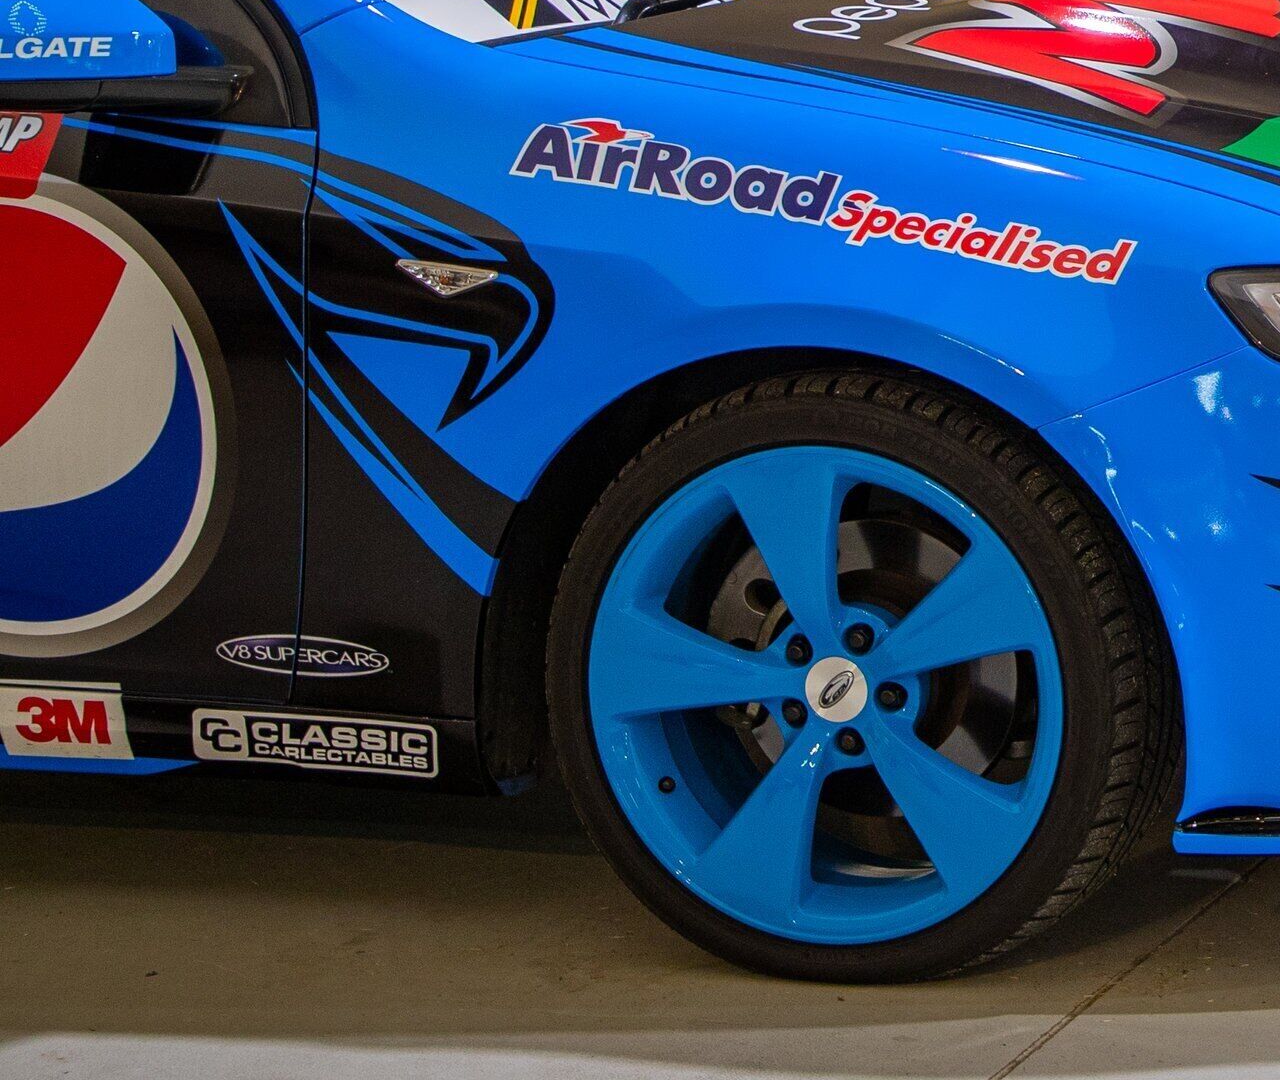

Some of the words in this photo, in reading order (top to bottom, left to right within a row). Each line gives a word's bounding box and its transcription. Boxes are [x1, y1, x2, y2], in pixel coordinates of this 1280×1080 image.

[0, 37, 113, 59] LGATE
[510, 121, 842, 224] AirRoad
[829, 189, 1138, 285] Specialised
[224, 644, 251, 659] V8
[253, 645, 387, 668] SUPERCARS
[16, 696, 111, 745] 3M
[251, 721, 429, 756] CLASSIC
[253, 743, 429, 770] CARLECTABLES
